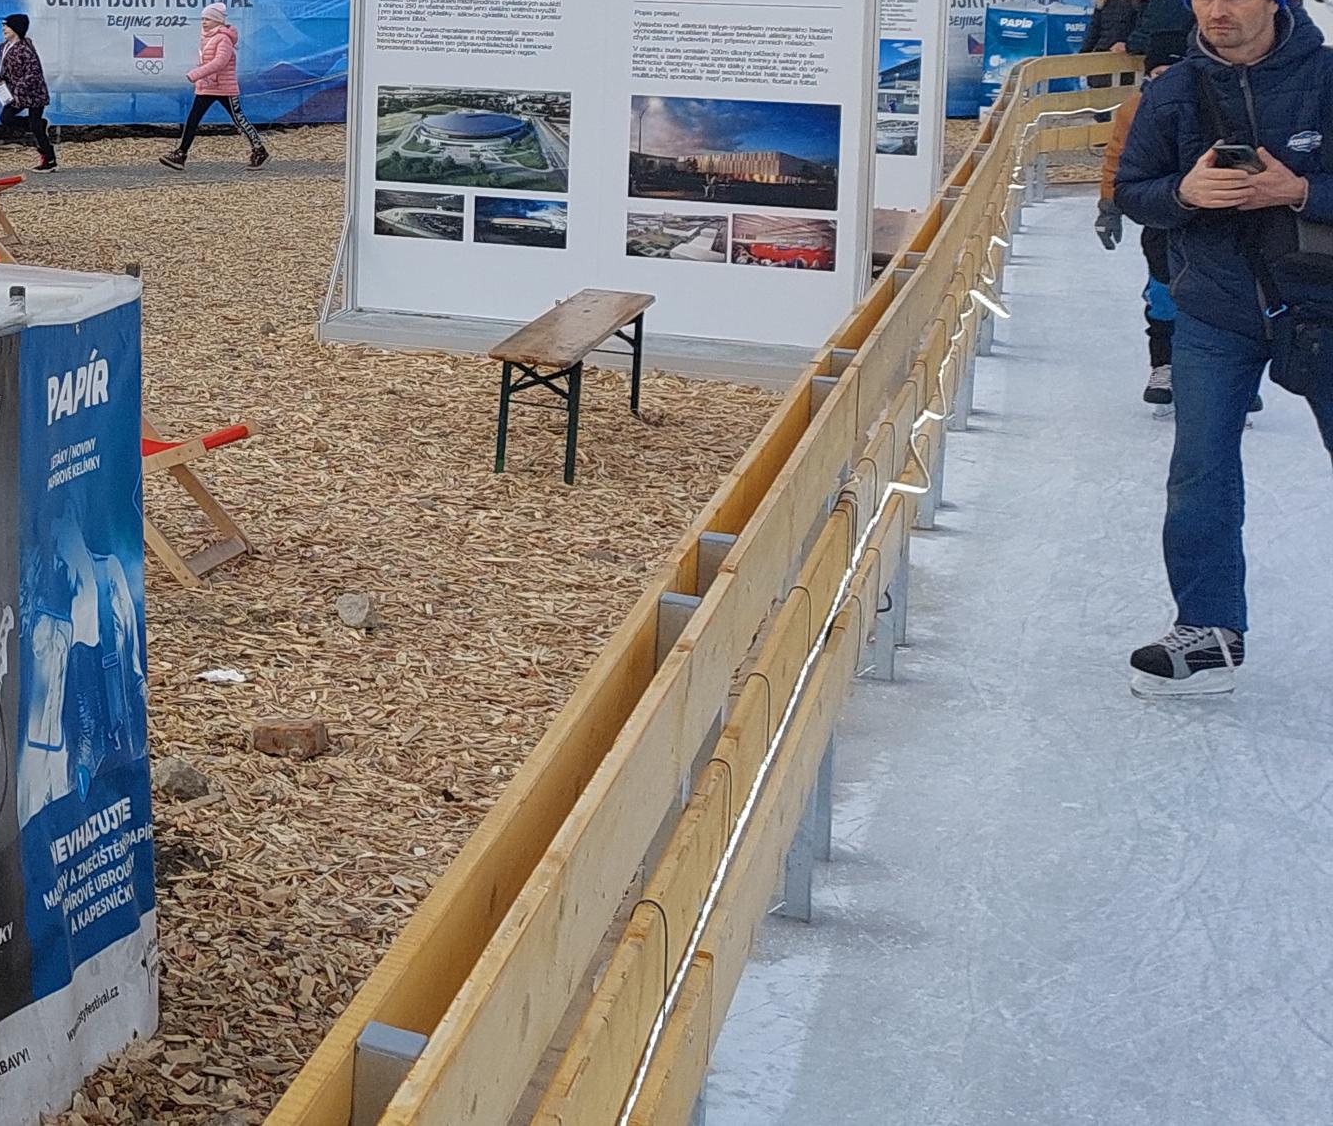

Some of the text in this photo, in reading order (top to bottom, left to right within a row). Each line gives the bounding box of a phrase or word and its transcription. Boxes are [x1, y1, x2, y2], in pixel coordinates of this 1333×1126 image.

[107, 13, 190, 30] BEIJING 2022
[1000, 17, 1034, 29] PAPÍR
[47, 348, 109, 426] PAPÍR
[77, 838, 128, 880] ZNEČIŠTĚN
